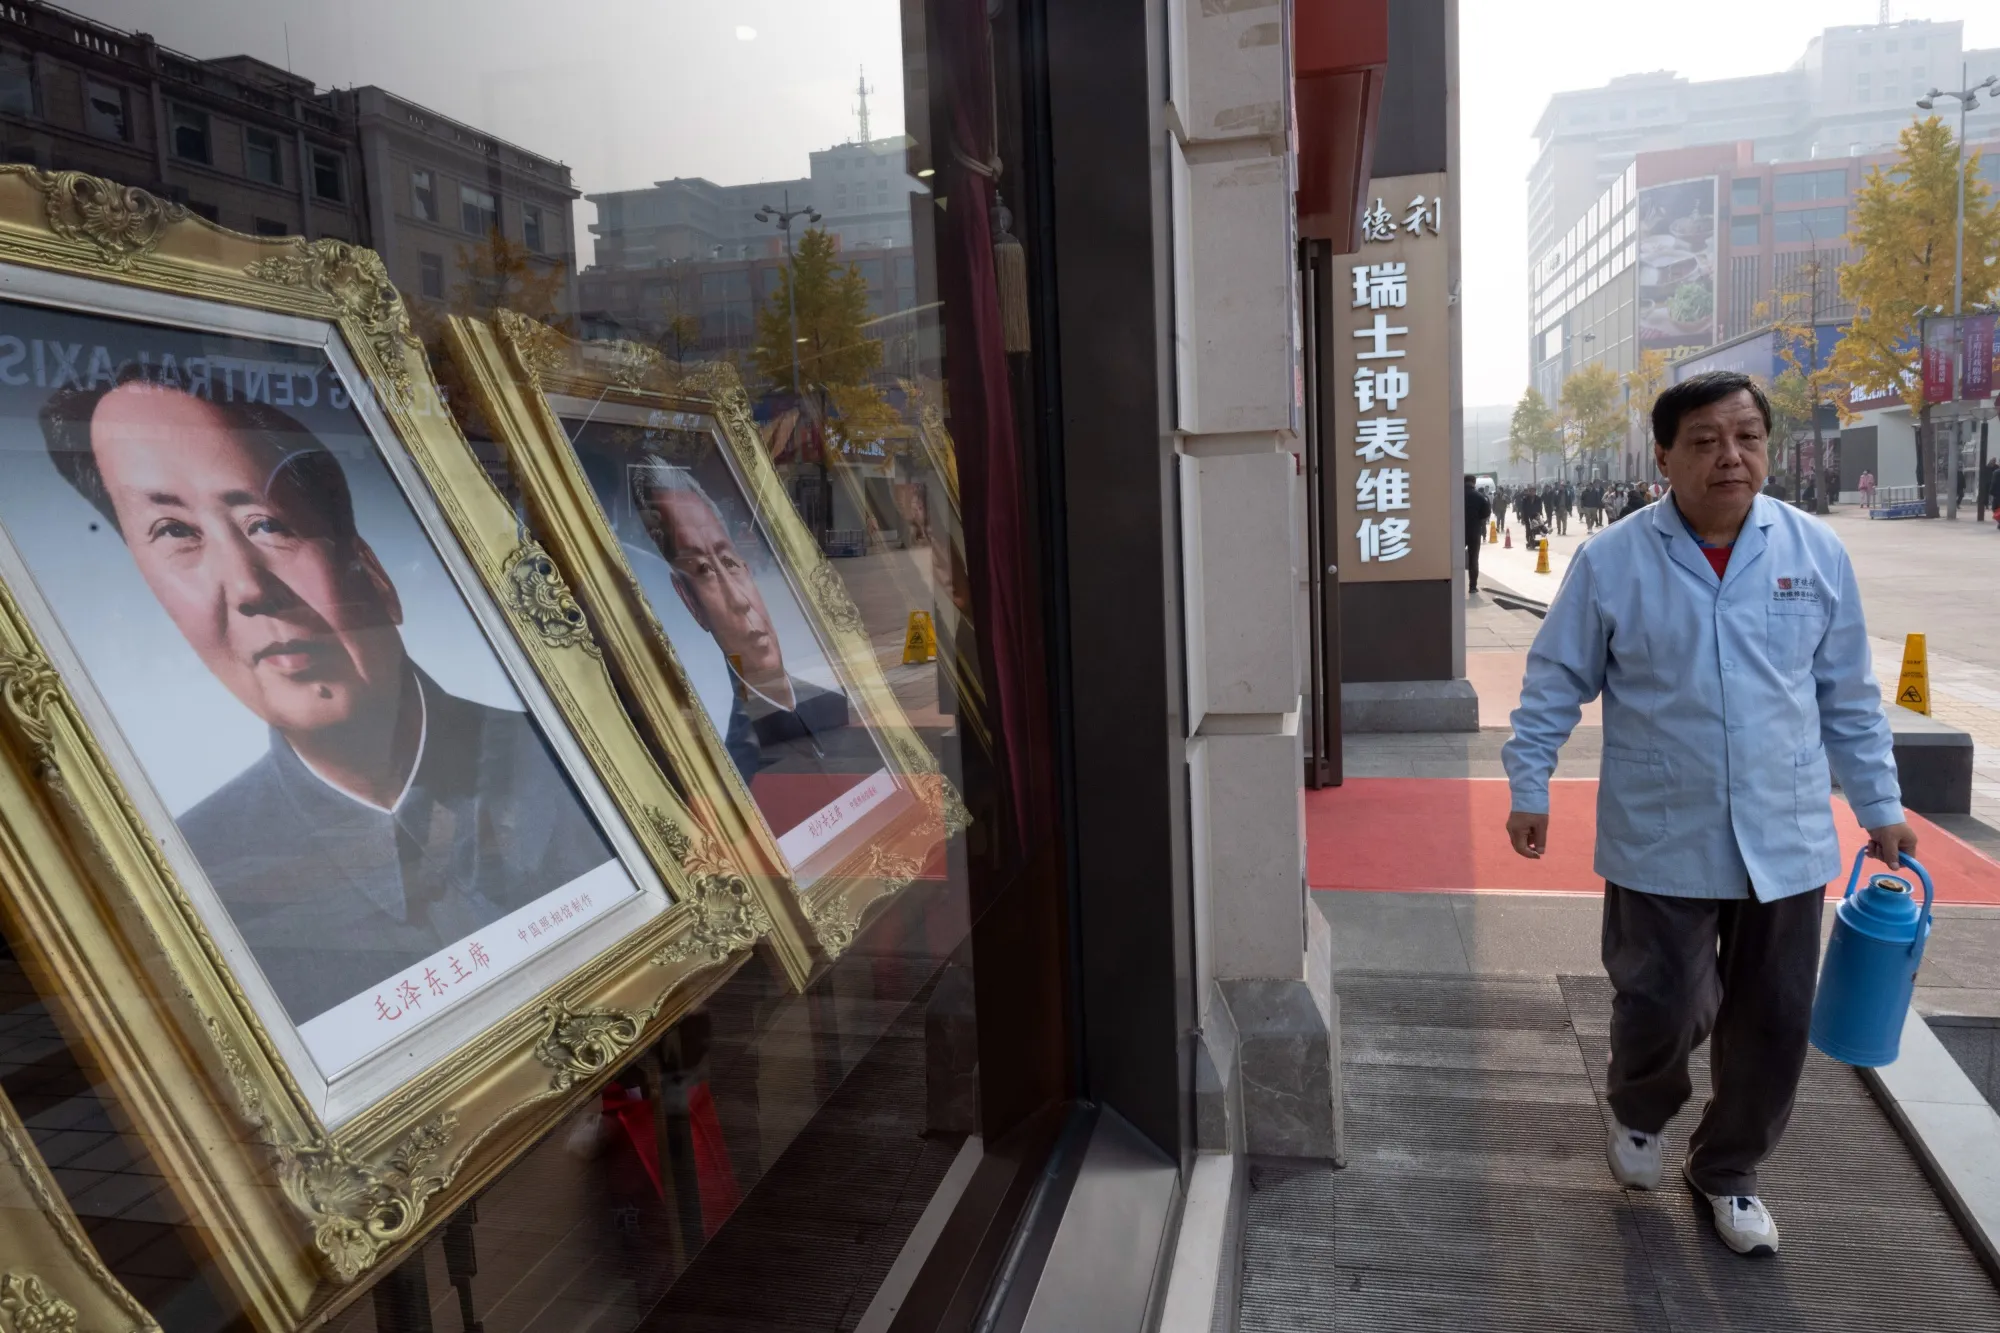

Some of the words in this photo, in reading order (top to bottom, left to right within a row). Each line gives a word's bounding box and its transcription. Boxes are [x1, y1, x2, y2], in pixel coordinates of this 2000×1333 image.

[1352, 261, 1412, 563] 瑞士钟表维修
[374, 941, 491, 1021] 毛泽东主席
[517, 892, 594, 944] 中国照相馆制作
